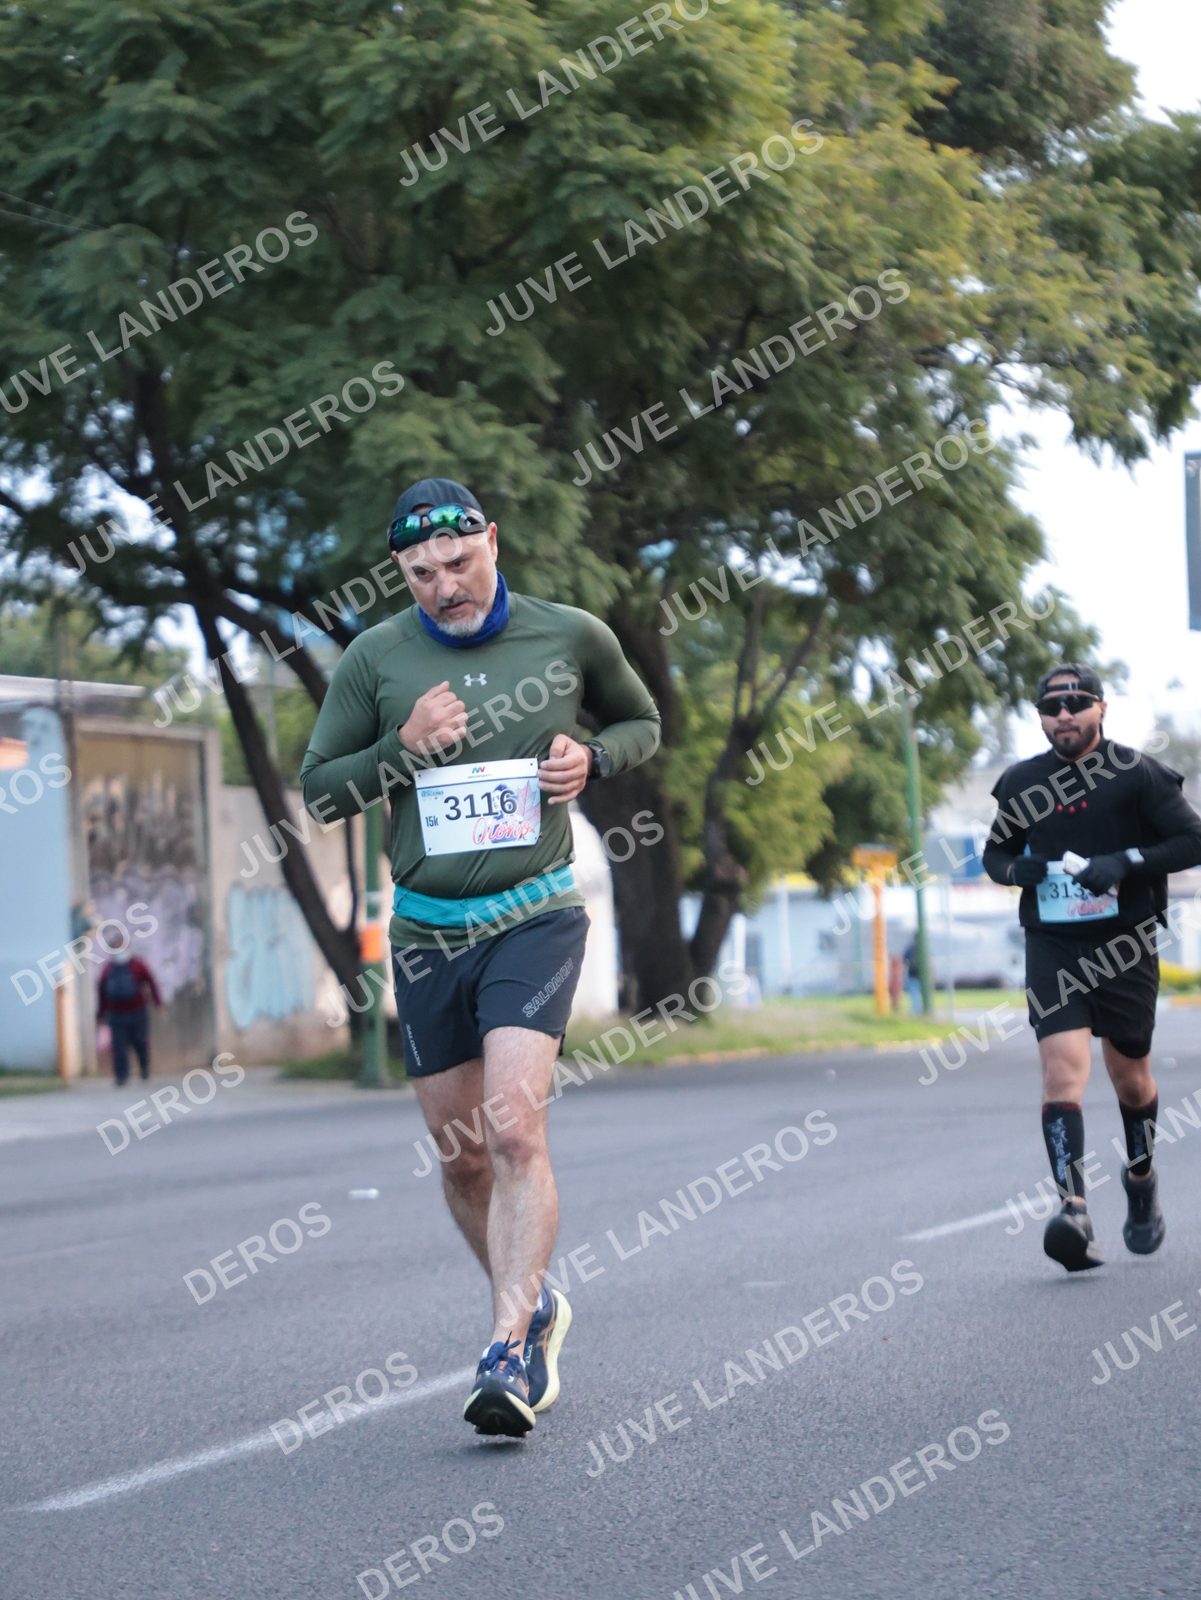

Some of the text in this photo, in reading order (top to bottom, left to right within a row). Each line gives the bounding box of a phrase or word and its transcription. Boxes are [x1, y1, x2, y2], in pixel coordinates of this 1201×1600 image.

[443, 789, 518, 821] 3116
[425, 816, 439, 828] 15k
[522, 957, 574, 1018] SALOMON
